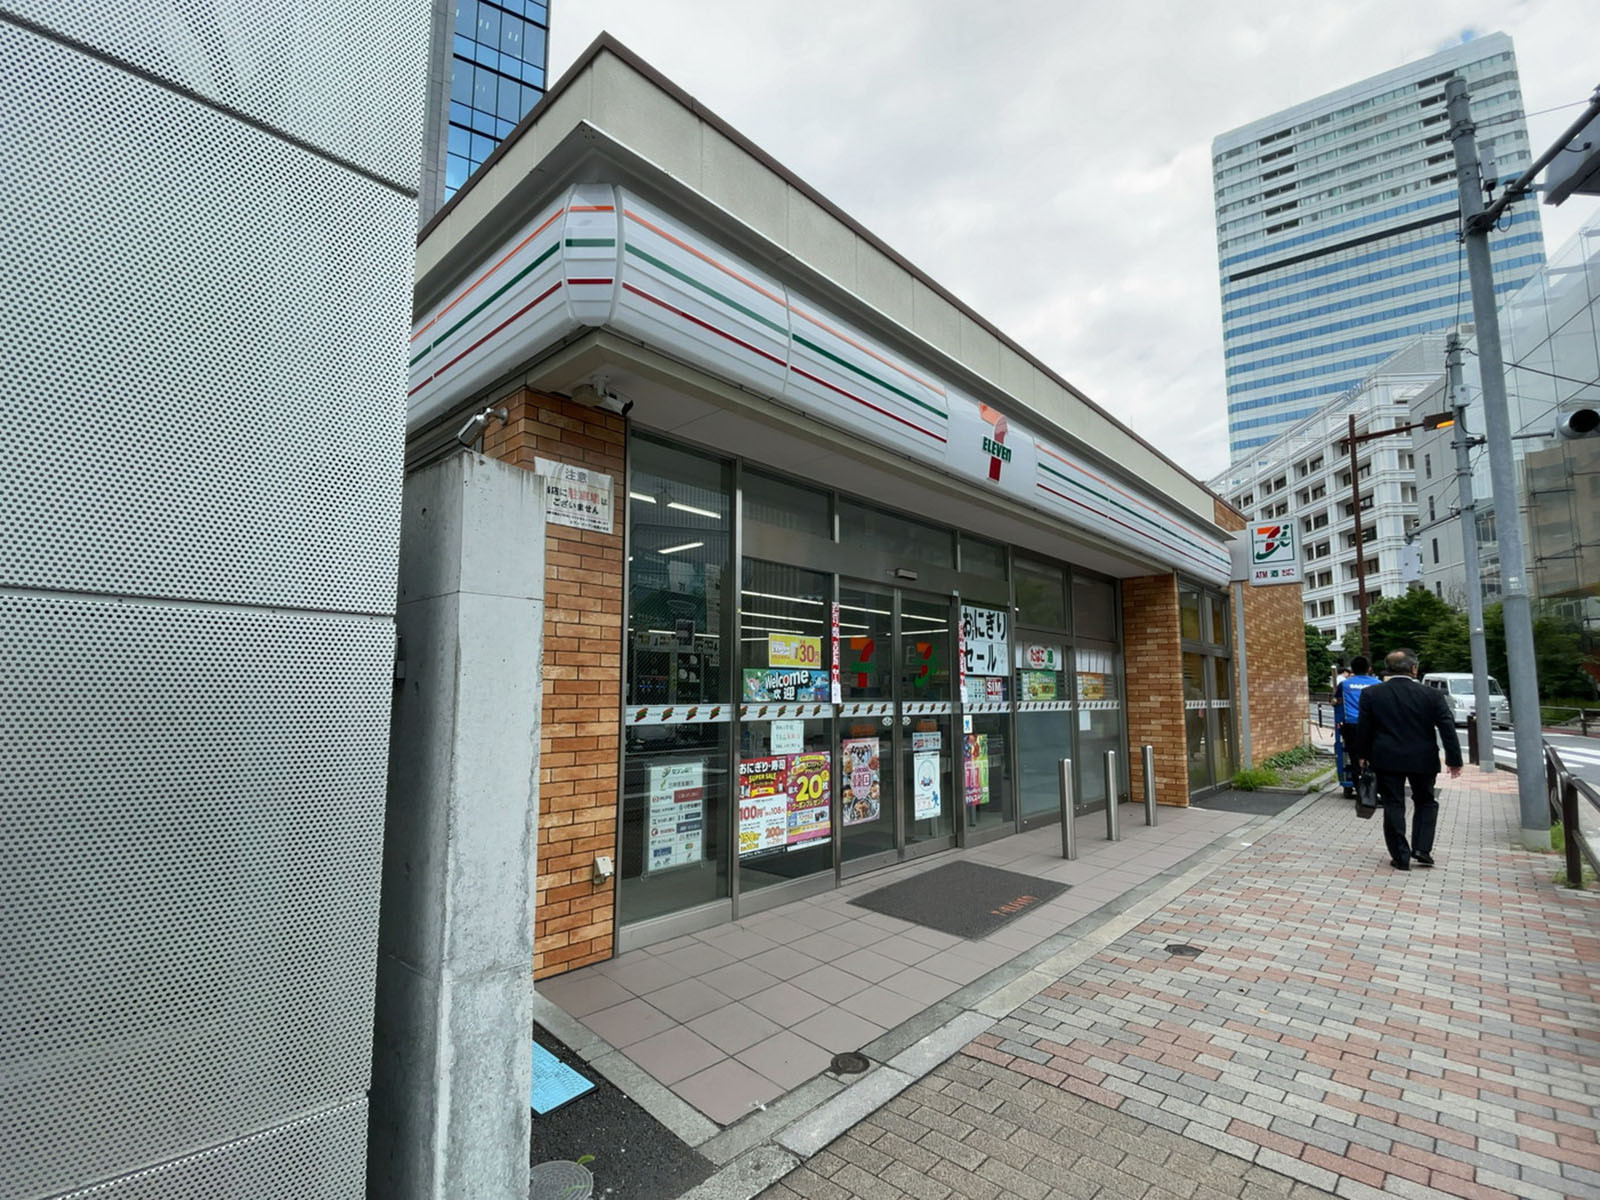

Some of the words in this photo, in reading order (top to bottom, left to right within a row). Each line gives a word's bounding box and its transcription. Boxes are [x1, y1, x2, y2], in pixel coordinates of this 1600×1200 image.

[565, 468, 588, 484] 注意
[553, 498, 599, 515] ございません
[1256, 570, 1268, 579] ATM
[962, 607, 1008, 641] おにぎり
[963, 641, 997, 673] セール
[765, 670, 809, 689] Welcome
[739, 759, 785, 774] おにぎり・寿司
[765, 772, 777, 780] SALE
[795, 774, 823, 802] 20
